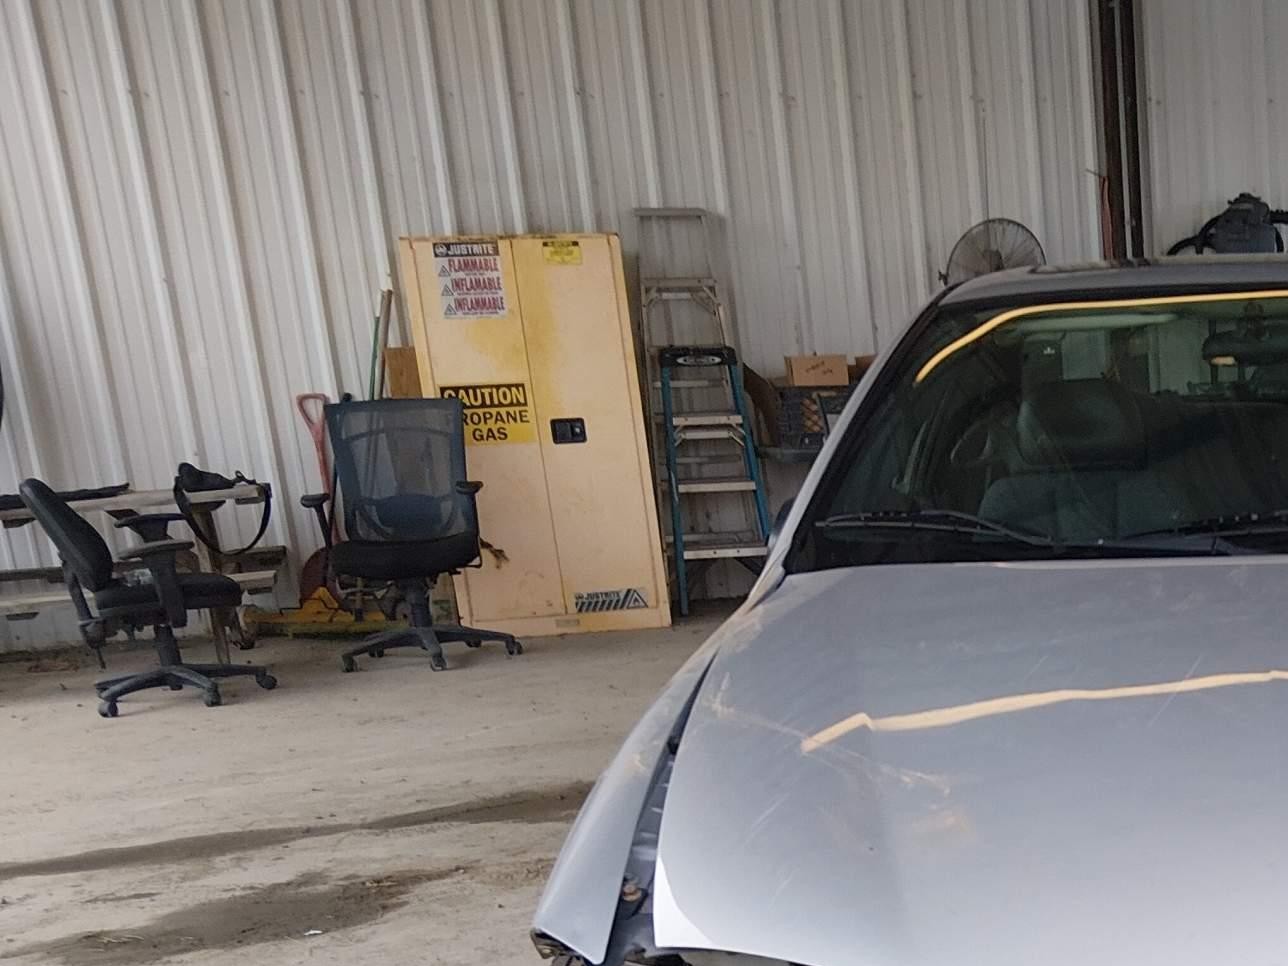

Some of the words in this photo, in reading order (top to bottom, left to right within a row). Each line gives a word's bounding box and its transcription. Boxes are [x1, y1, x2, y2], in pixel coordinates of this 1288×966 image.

[448, 244, 497, 255] JUSTRITE
[448, 258, 499, 272] FLAMMABLE
[451, 277, 502, 292] INFLAMABLE
[454, 296, 505, 312] INFLAMMABLE
[463, 410, 530, 426] OPANE
[472, 427, 508, 442] GAS
